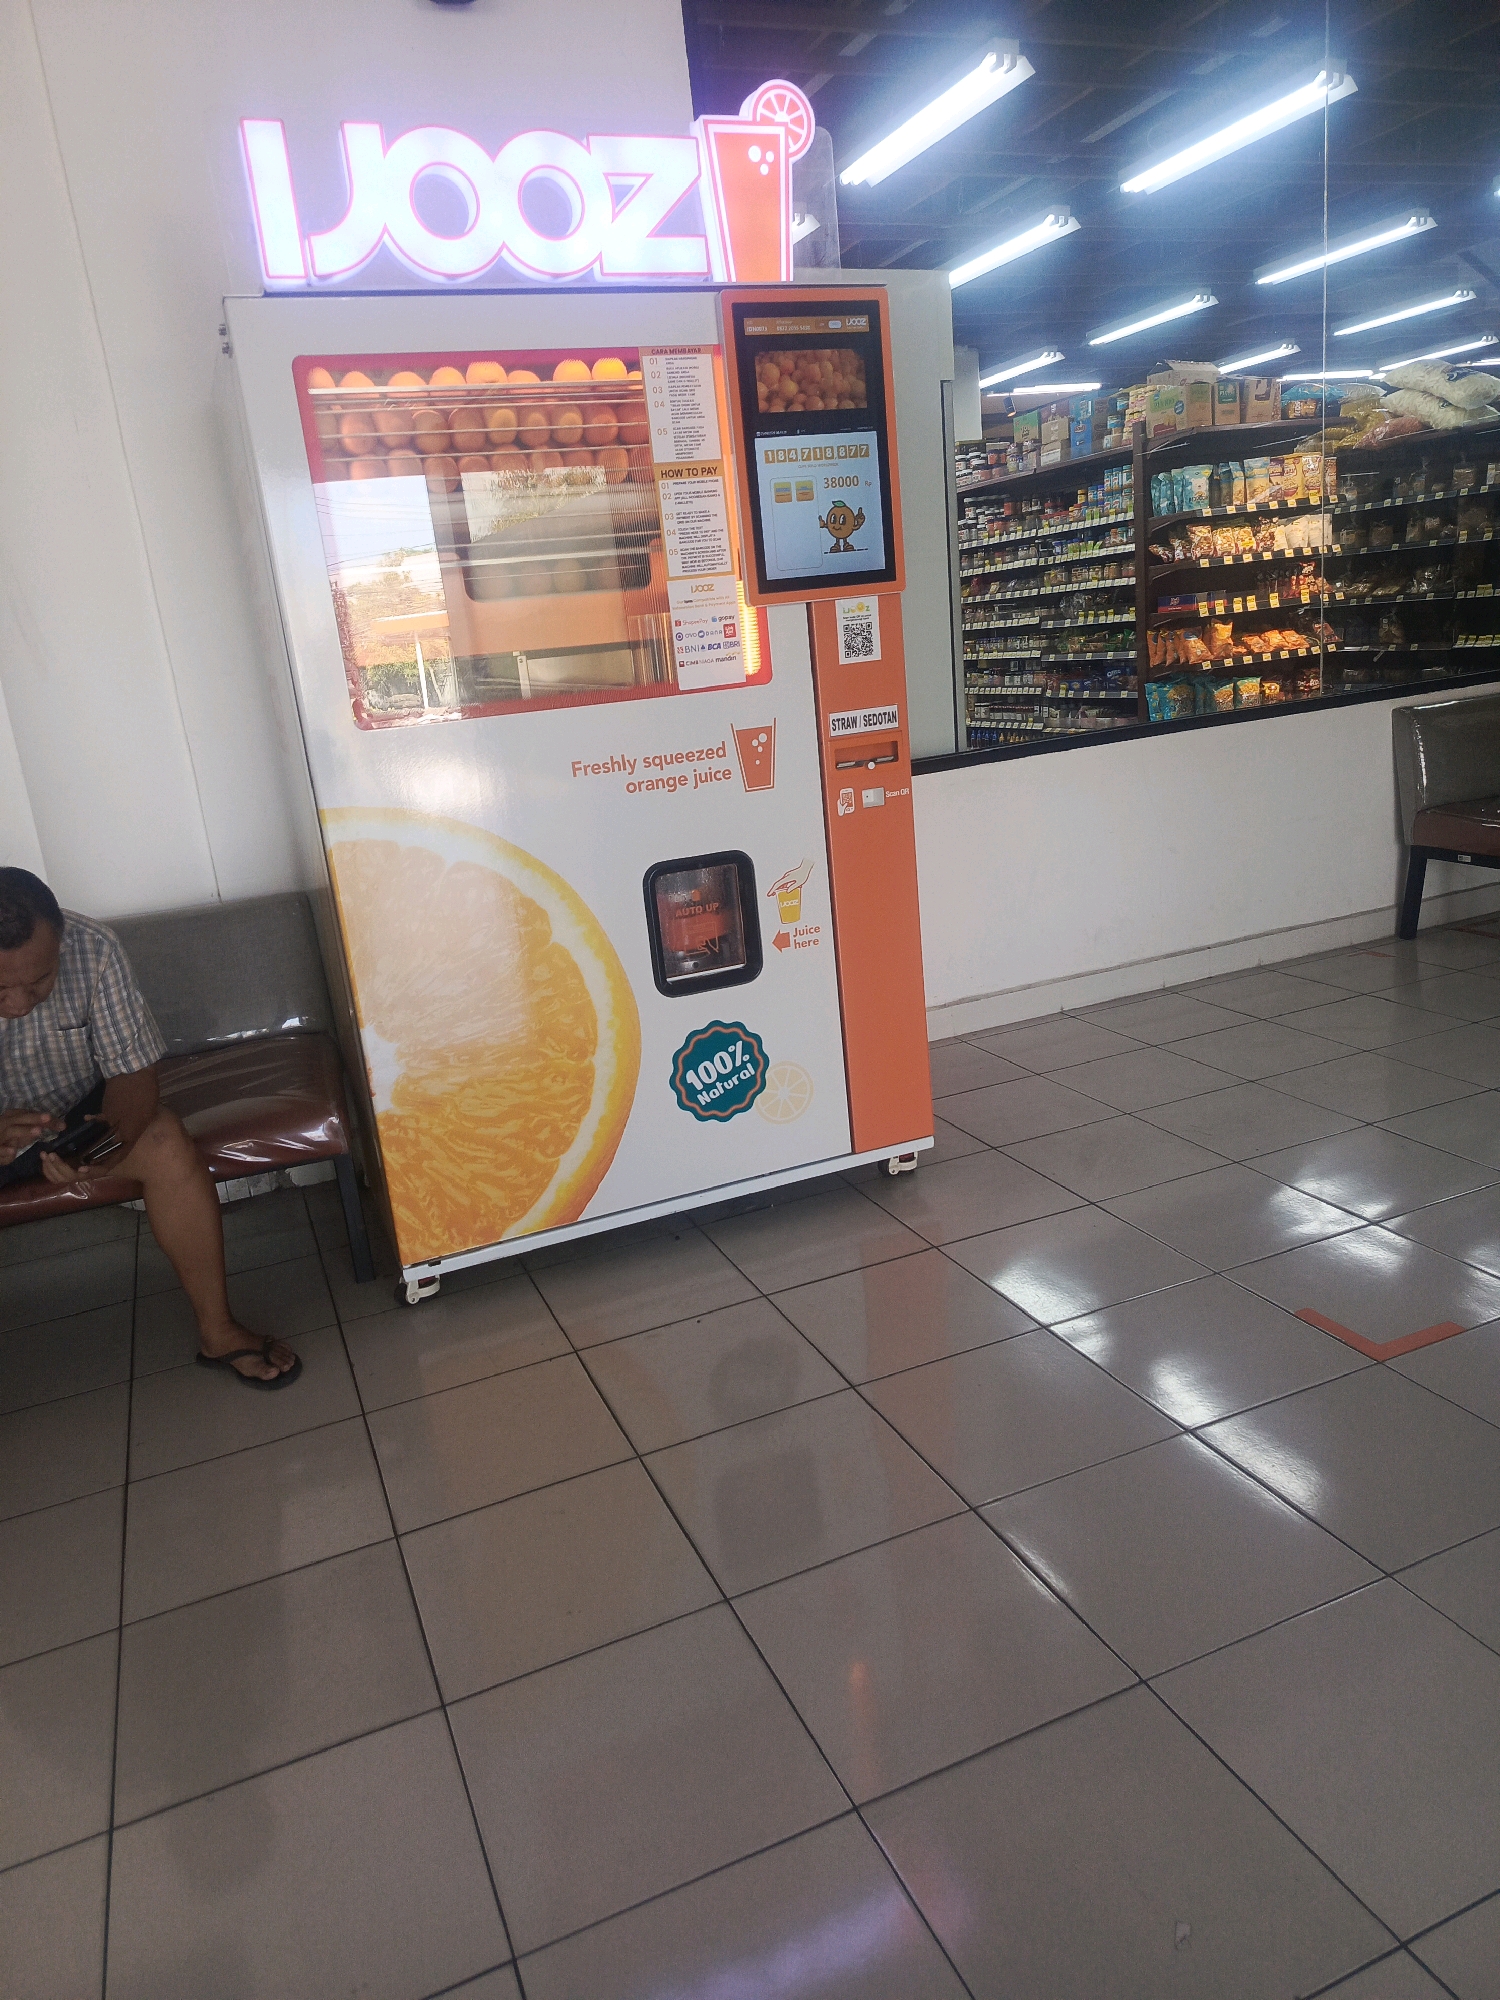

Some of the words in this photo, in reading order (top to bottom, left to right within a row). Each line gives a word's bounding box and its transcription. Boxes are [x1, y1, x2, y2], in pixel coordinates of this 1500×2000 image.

[240, 117, 711, 284] IJOOZ
[651, 371, 661, 379] 02
[652, 386, 662, 394] 03
[658, 428, 668, 436] 05
[765, 444, 869, 462] 184,718,877
[660, 469, 684, 478] HOW
[685, 468, 698, 476] TO
[701, 466, 718, 476] PAY
[661, 482, 670, 490] 01
[824, 475, 860, 489] 38000
[685, 645, 700, 654] BNI
[831, 714, 858, 732] STRAW
[863, 710, 897, 728] SEDOTAN
[571, 754, 637, 778] Freshly
[642, 740, 727, 771] squeezed
[626, 774, 688, 794] orange
[692, 766, 732, 790] juice
[885, 790, 900, 798] Scan
[900, 788, 910, 796] QR
[675, 906, 703, 918] AUTO
[706, 902, 720, 912] UP
[793, 925, 821, 938] Juice
[794, 938, 820, 950] here
[686, 1040, 750, 1091] 100%
[696, 1062, 756, 1106] Natural
